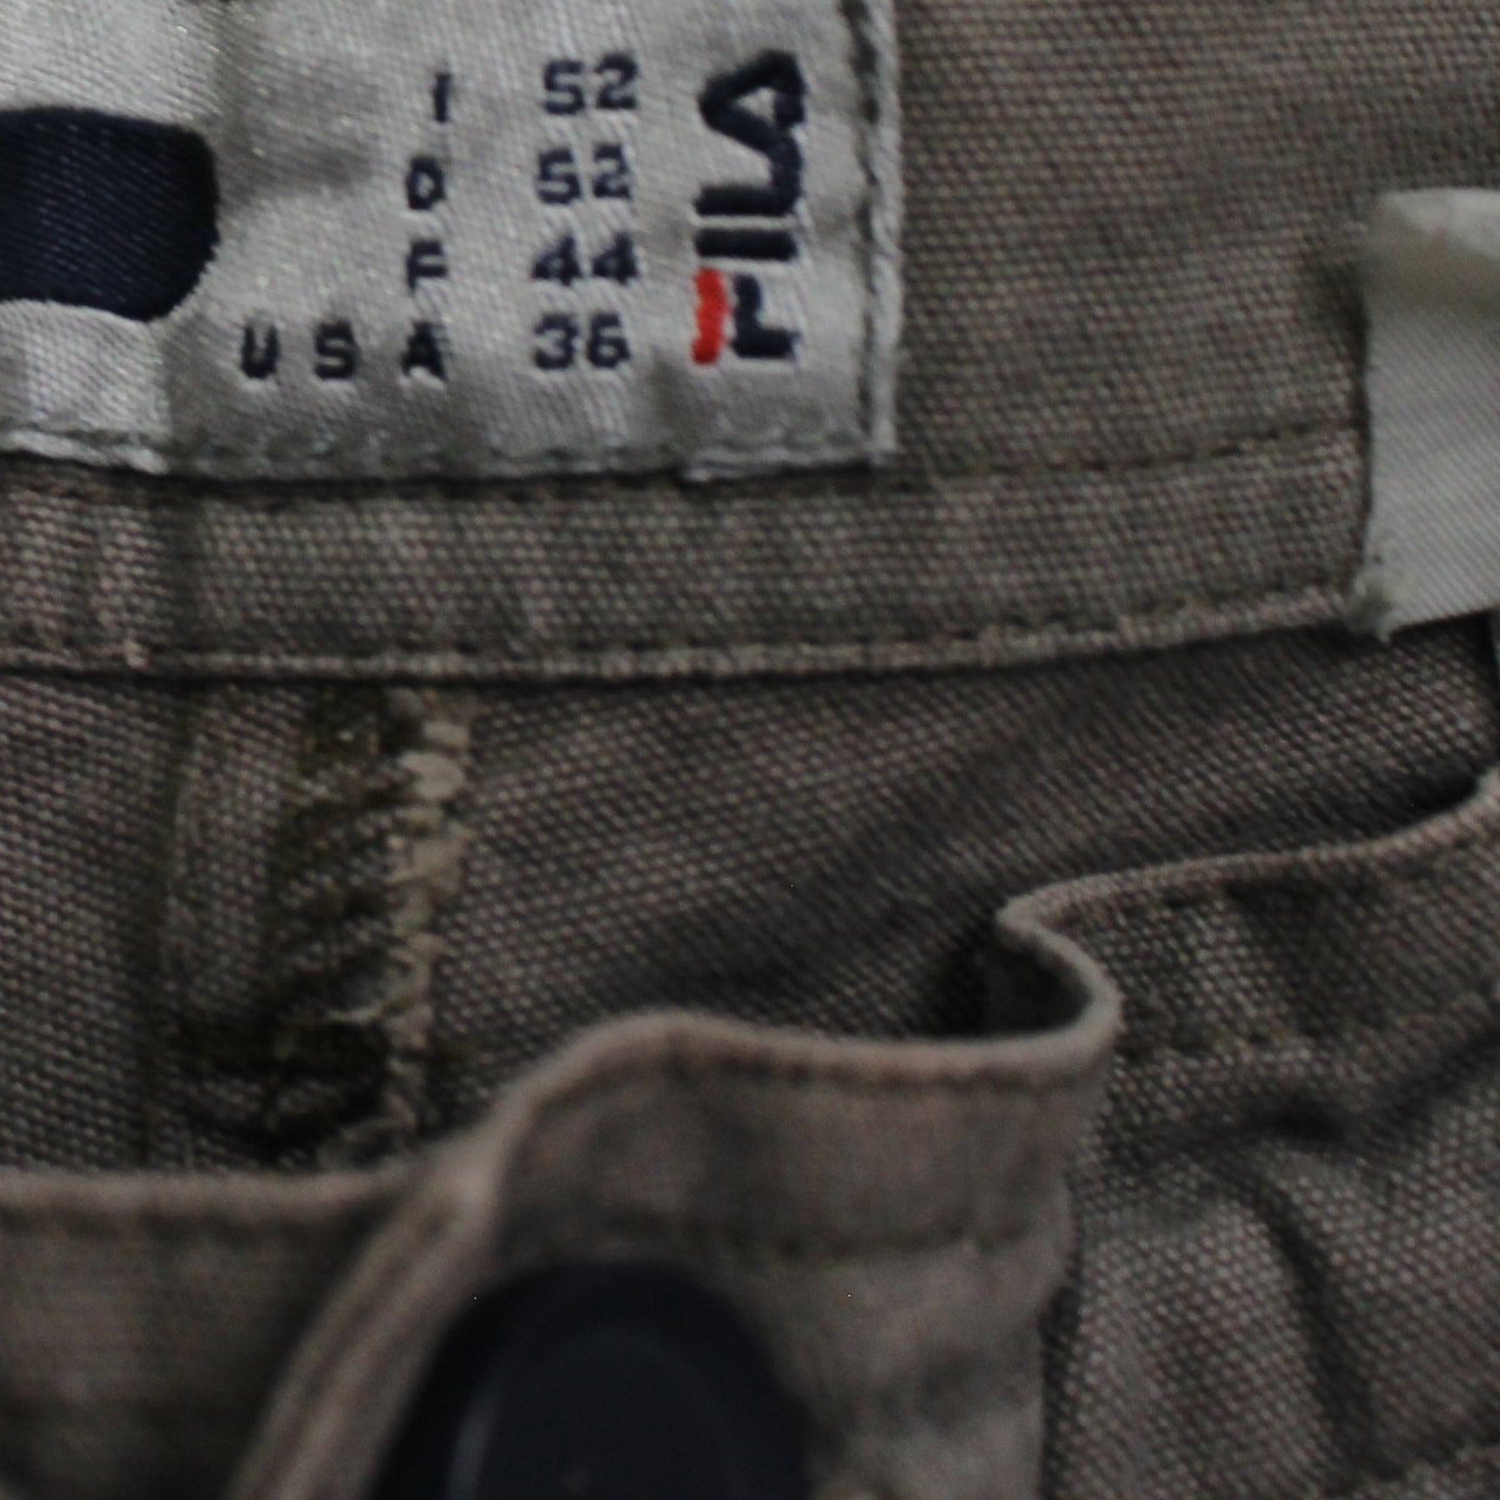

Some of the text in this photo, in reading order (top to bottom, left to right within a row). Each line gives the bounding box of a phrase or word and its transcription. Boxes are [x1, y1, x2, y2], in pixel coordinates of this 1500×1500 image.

[430, 53, 639, 123] I 52
[534, 143, 633, 205] 52
[690, 48, 807, 366] FILA
[406, 232, 639, 291] F 44
[532, 311, 632, 372] 36
